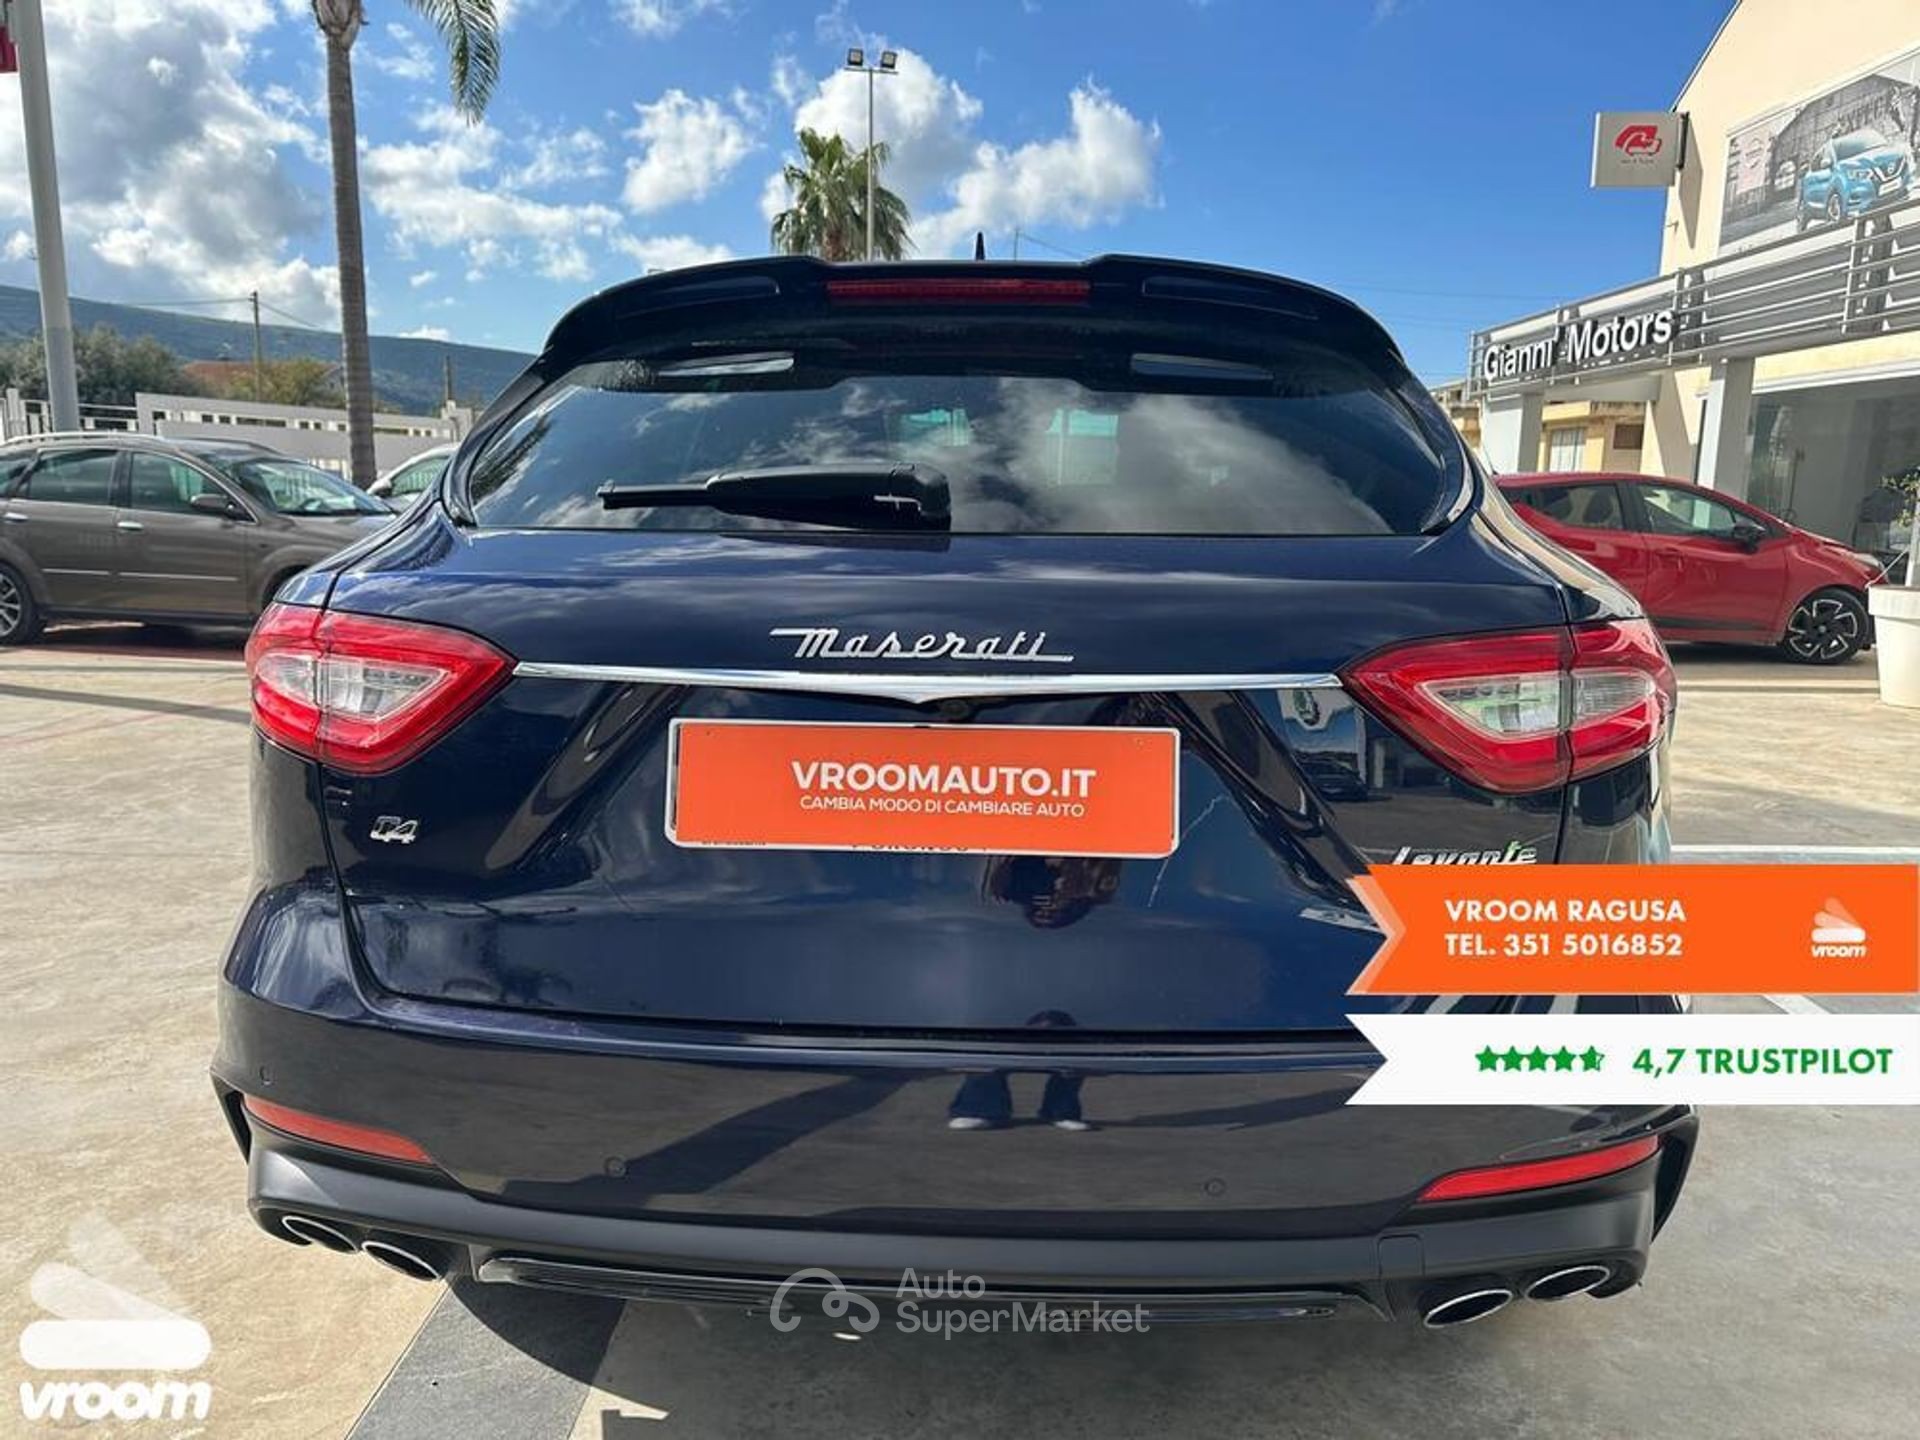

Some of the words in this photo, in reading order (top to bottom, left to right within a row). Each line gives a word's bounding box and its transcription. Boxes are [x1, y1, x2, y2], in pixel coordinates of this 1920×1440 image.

[1484, 338, 1555, 381] Gianni
[1567, 309, 1672, 363] Motors
[769, 628, 1075, 662] Maserati
[792, 761, 1097, 798] VROOMAUTO.IT
[800, 795, 866, 811] CAMBIA
[868, 797, 921, 813] MODO
[925, 798, 941, 813] DI
[945, 799, 1032, 815] CAMBIARE
[1036, 802, 1085, 817] AUTO
[370, 816, 418, 844] Q4
